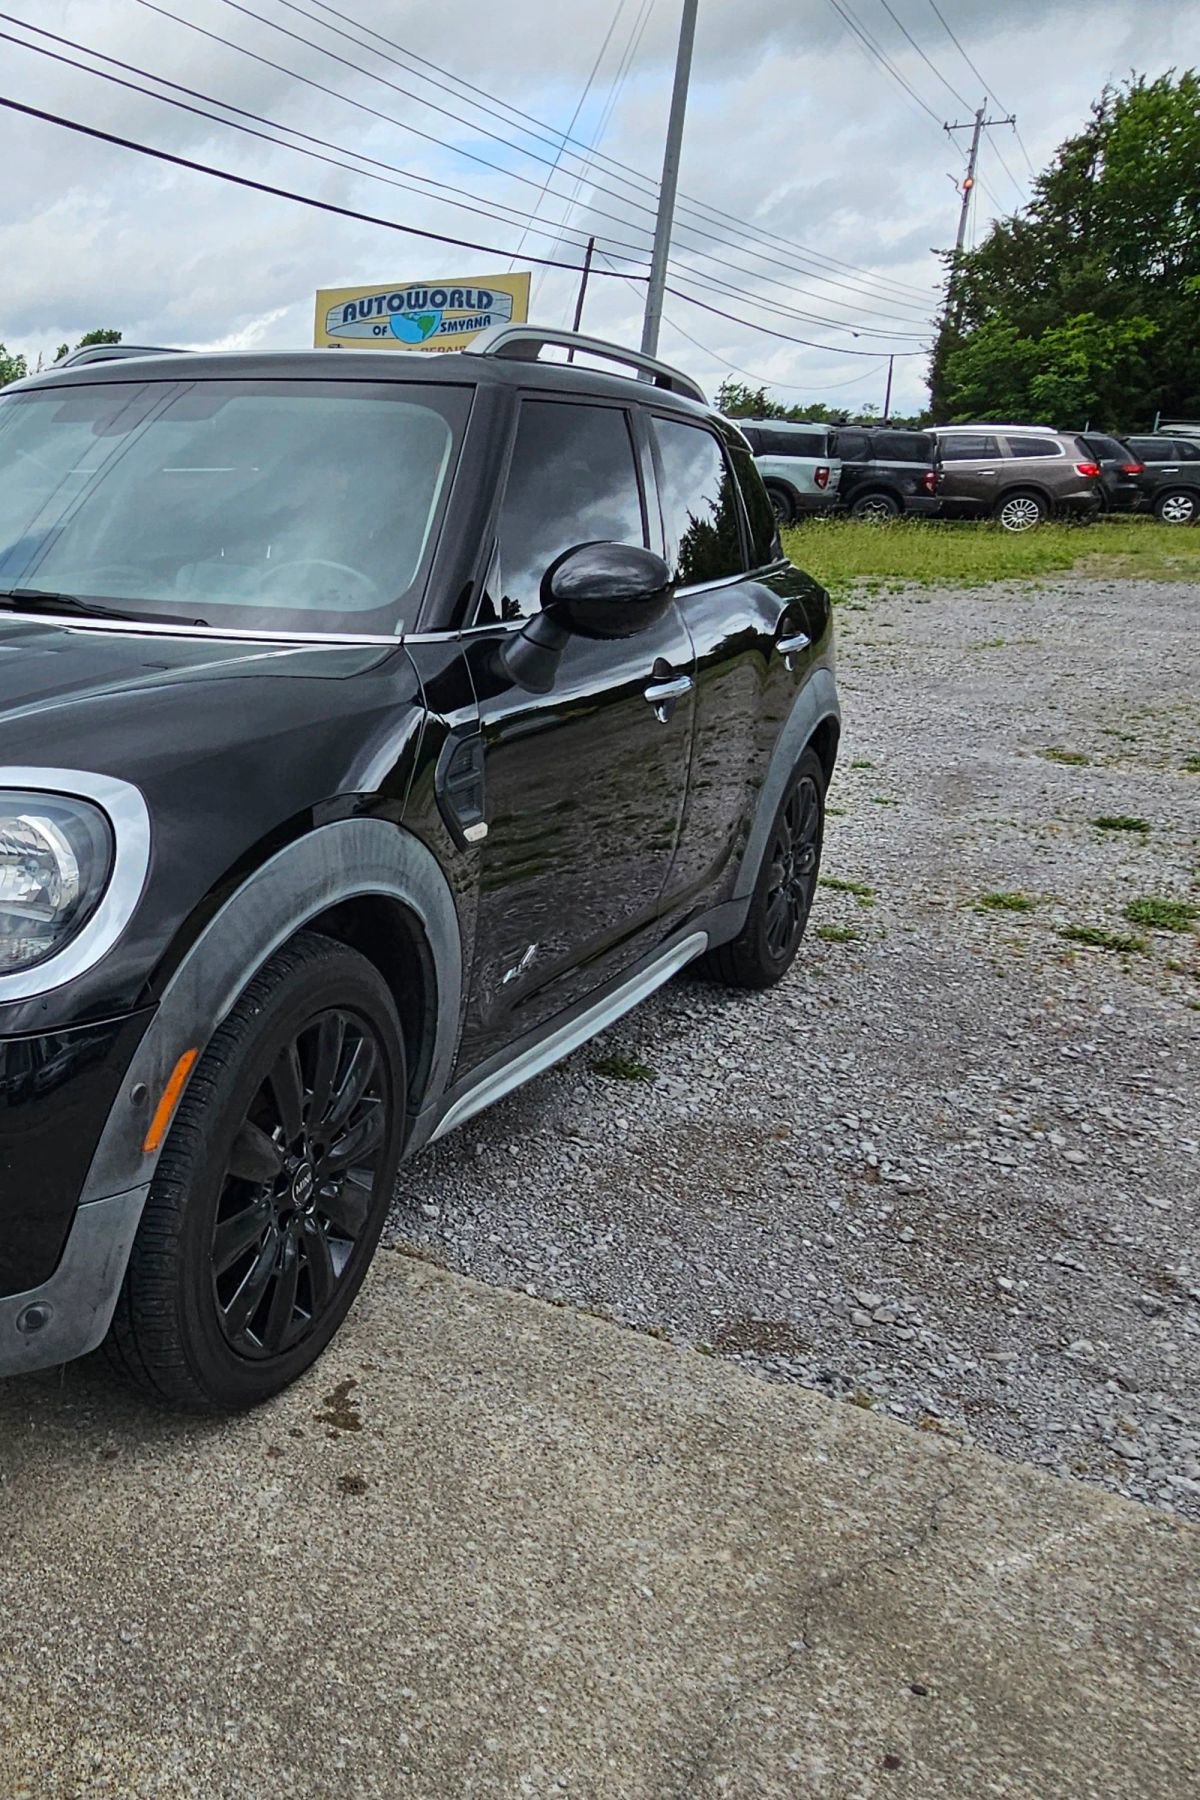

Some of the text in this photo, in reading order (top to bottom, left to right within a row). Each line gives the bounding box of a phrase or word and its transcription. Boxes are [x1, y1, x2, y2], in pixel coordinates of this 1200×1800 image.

[342, 289, 494, 324] AUTOWORLD
[372, 315, 492, 336] OF SMYRNA
[295, 1171, 312, 1196] MINI
